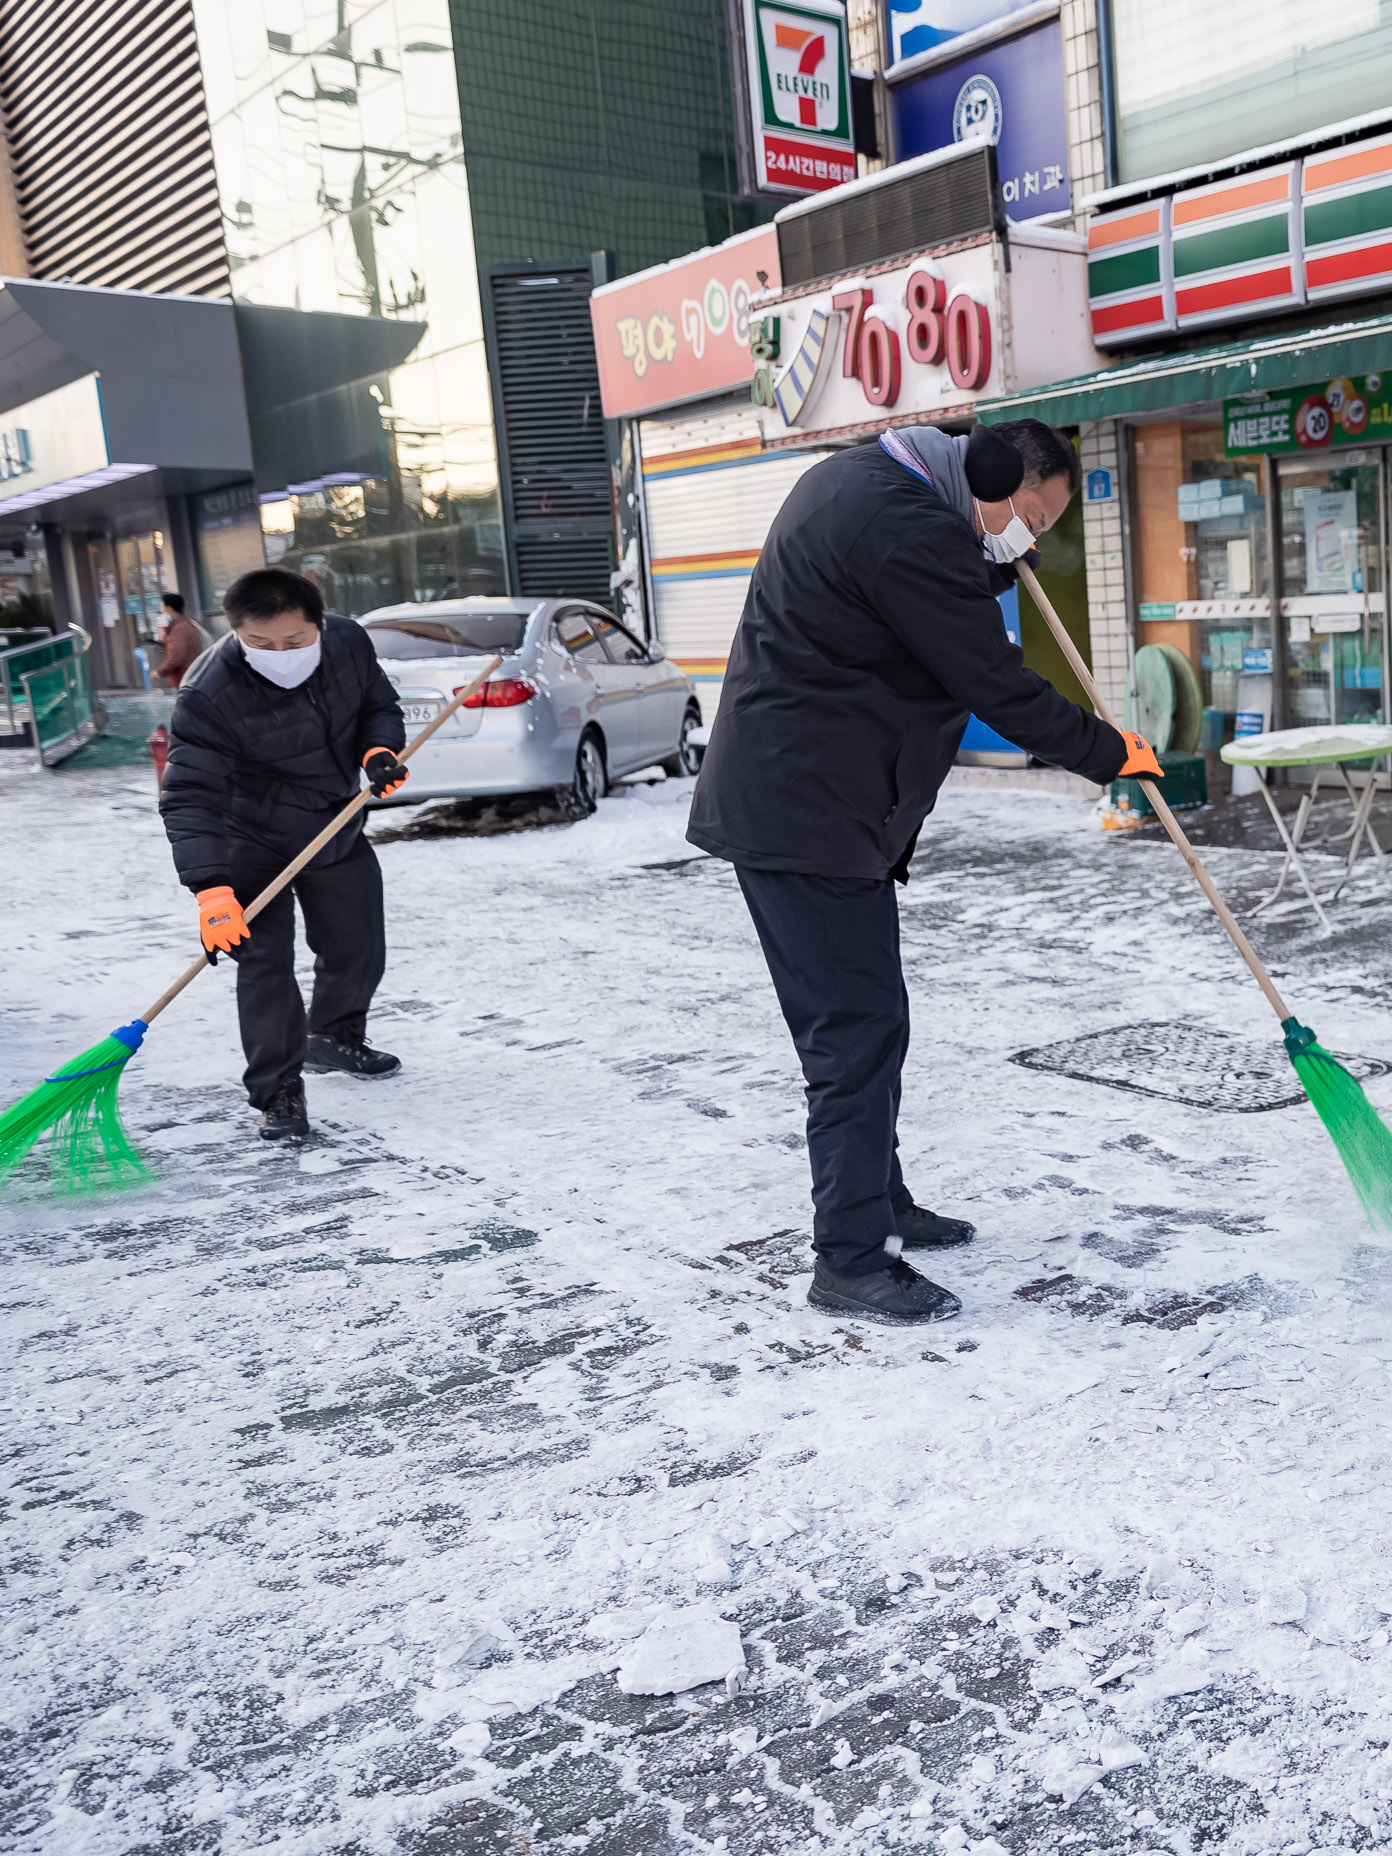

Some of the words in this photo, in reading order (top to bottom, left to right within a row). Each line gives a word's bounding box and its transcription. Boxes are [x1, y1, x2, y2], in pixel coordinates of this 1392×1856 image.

[774, 23, 825, 127] 7
[616, 311, 678, 378] 평야
[832, 270, 991, 408] 7080
[1227, 413, 1291, 449] 세븐로또
